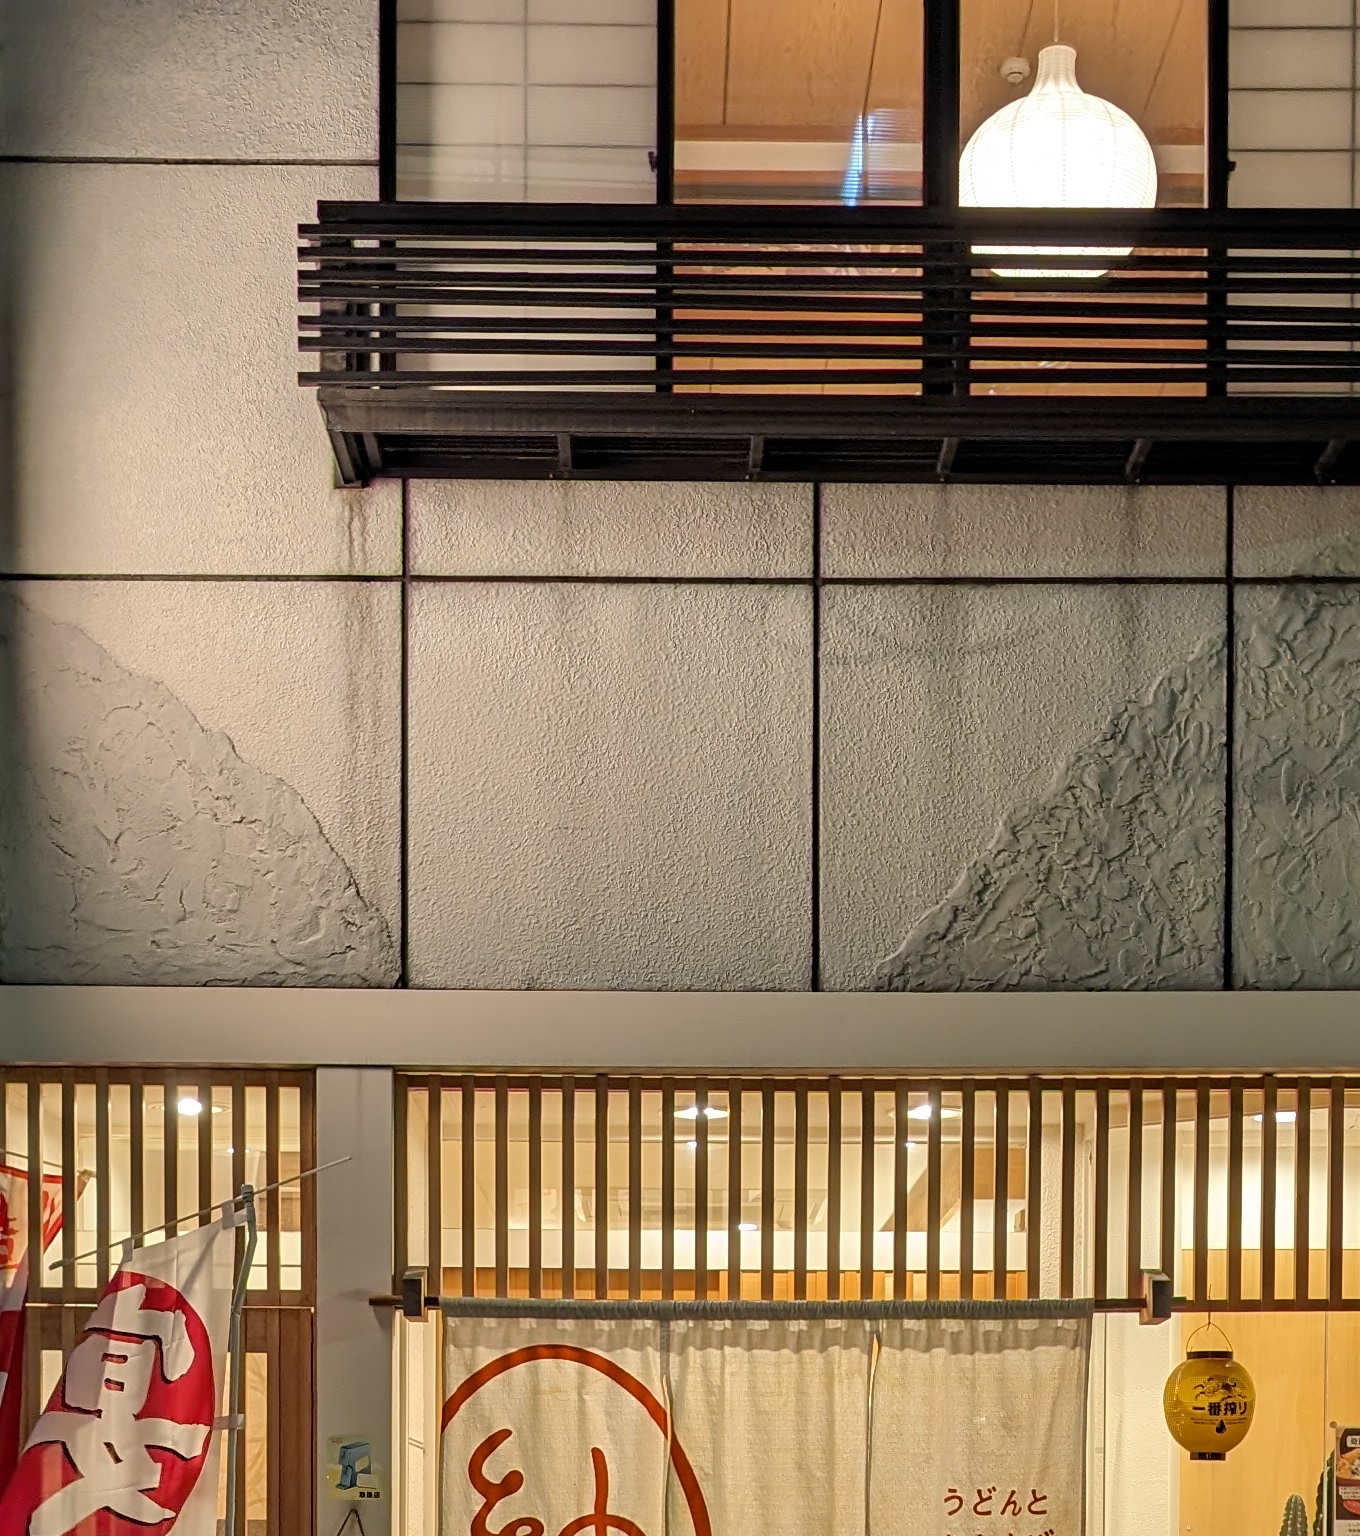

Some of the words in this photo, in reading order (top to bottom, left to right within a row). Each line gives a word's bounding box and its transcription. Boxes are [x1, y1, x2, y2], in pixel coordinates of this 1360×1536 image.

[1192, 1401, 1247, 1416] 一番搾り
[943, 1486, 1050, 1517] うどんと
